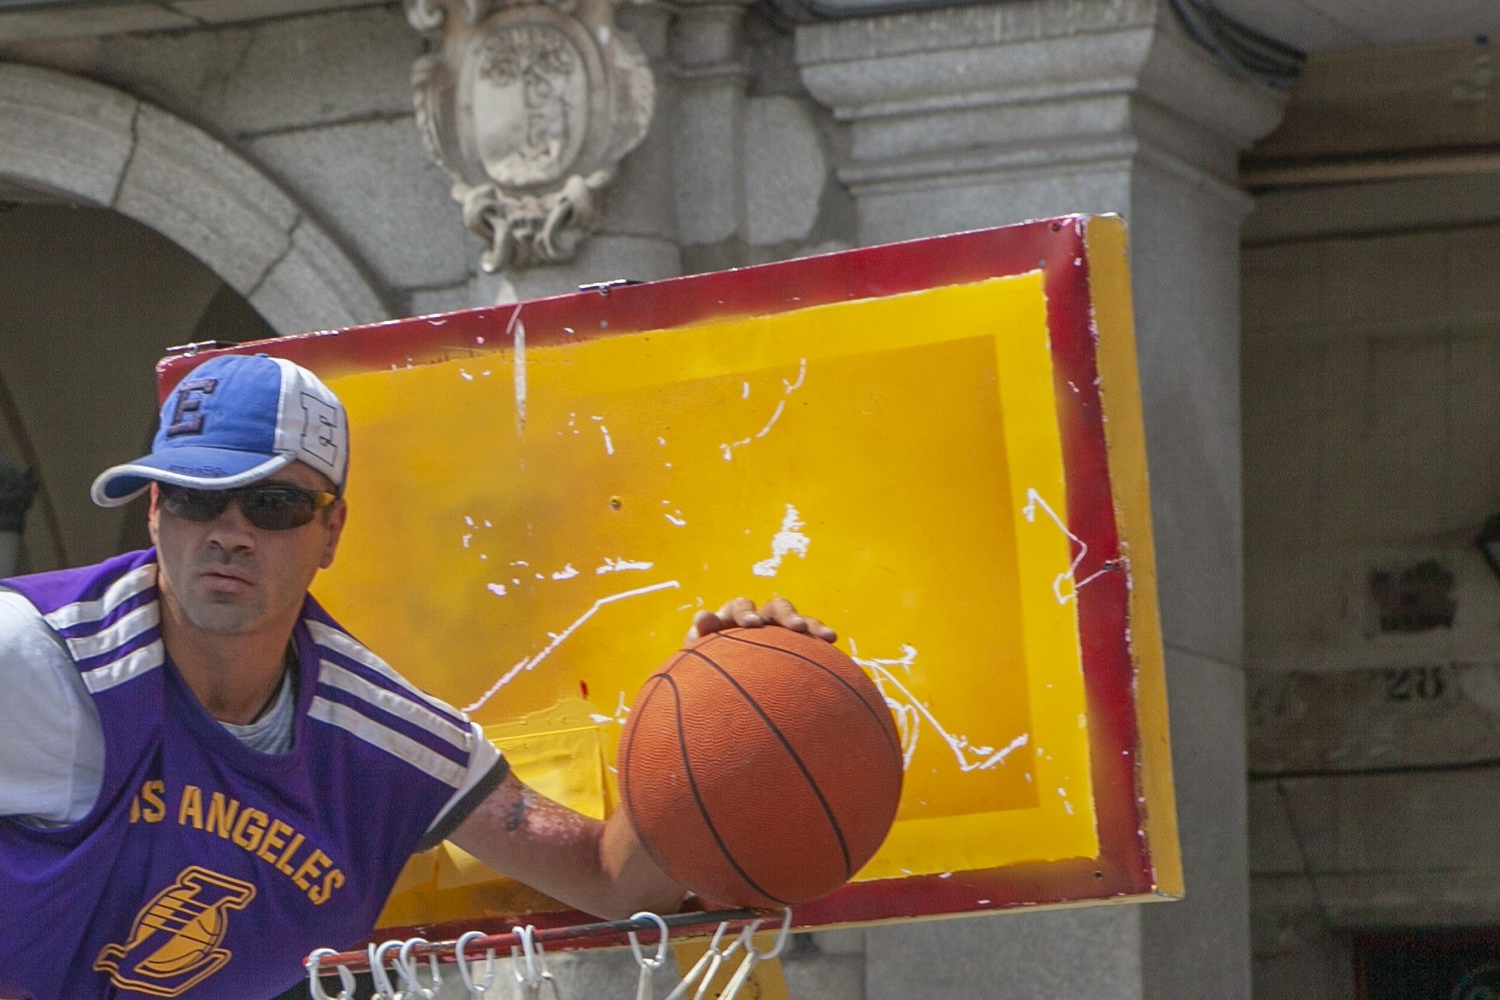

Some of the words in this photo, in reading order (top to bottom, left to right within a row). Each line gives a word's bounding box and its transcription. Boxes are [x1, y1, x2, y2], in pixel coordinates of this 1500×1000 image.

[167, 378, 218, 438] E
[300, 391, 338, 468] E
[1383, 665, 1445, 701] 28
[177, 784, 346, 906] ANGELES
